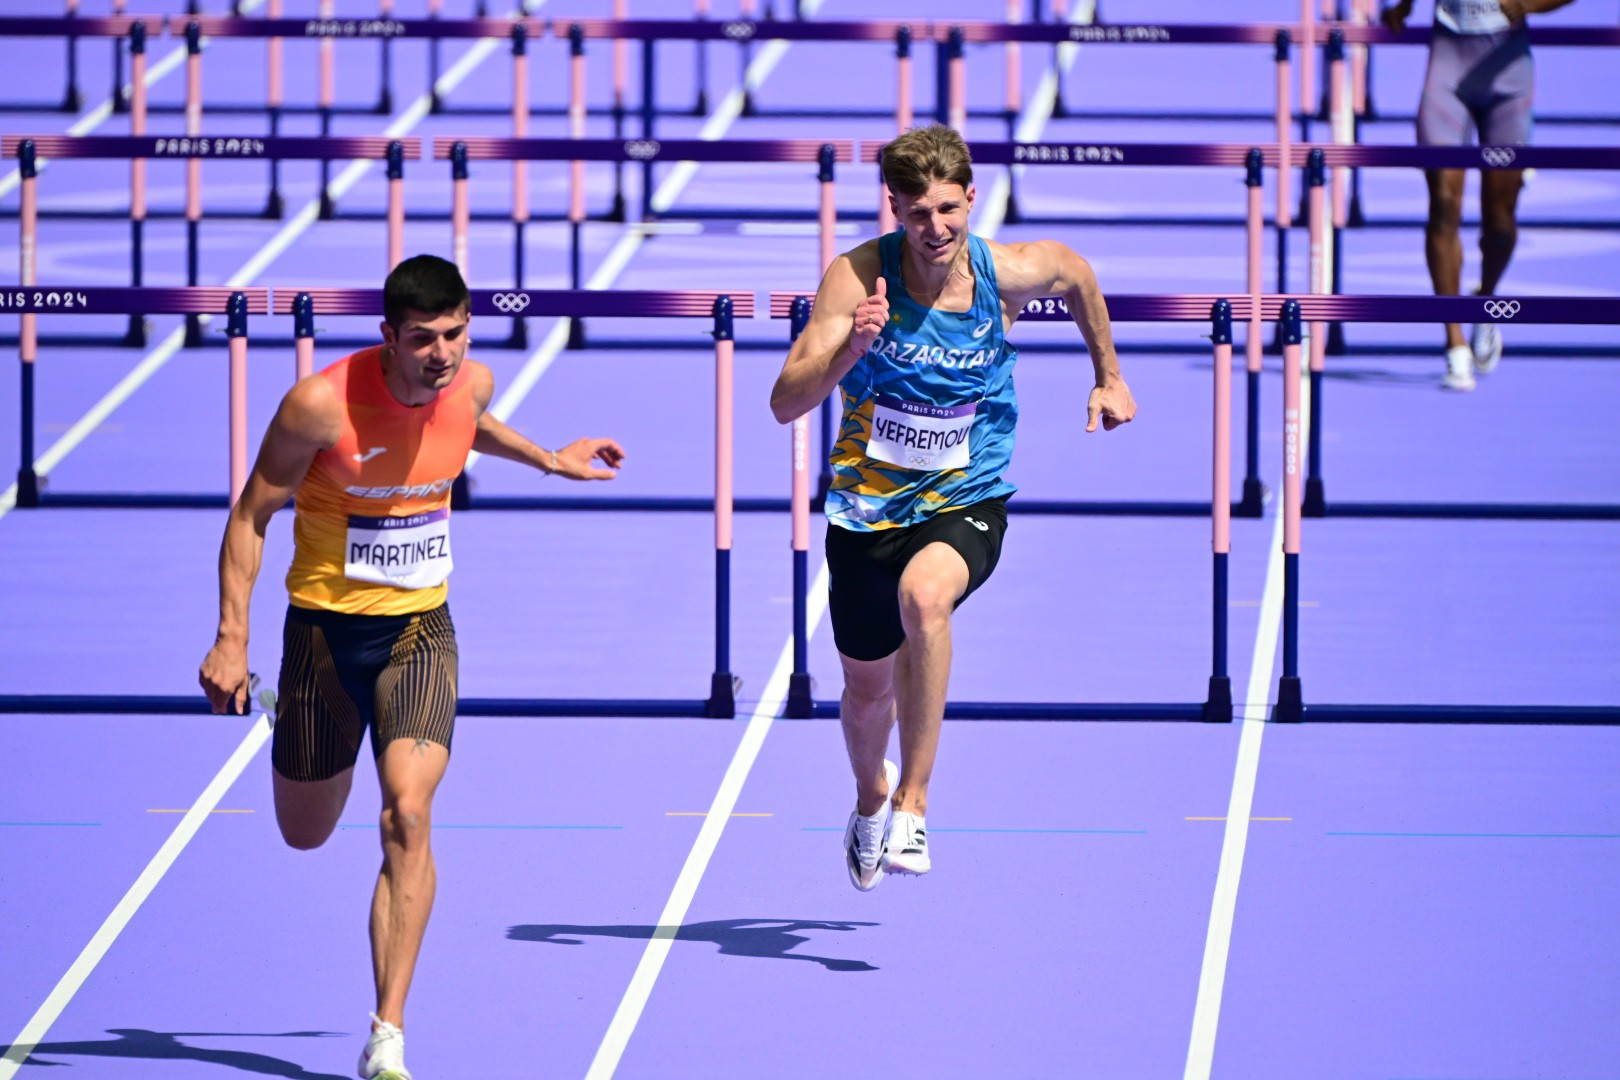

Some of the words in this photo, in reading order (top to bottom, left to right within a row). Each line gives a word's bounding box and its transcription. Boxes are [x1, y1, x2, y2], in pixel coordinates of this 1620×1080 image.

[155, 138, 210, 155] PARIS
[214, 139, 264, 155] 2024
[1014, 146, 1069, 162] PARIS
[1073, 146, 1124, 163] 2024
[33, 292, 87, 308] 2024
[1019, 299, 1068, 315] 024
[869, 335, 1000, 370] QAZAQSTAN
[901, 403, 928, 415] PARIS
[931, 408, 956, 417] 2024
[875, 417, 970, 452] YEFREMOV
[350, 534, 448, 567] MARTINEZ
